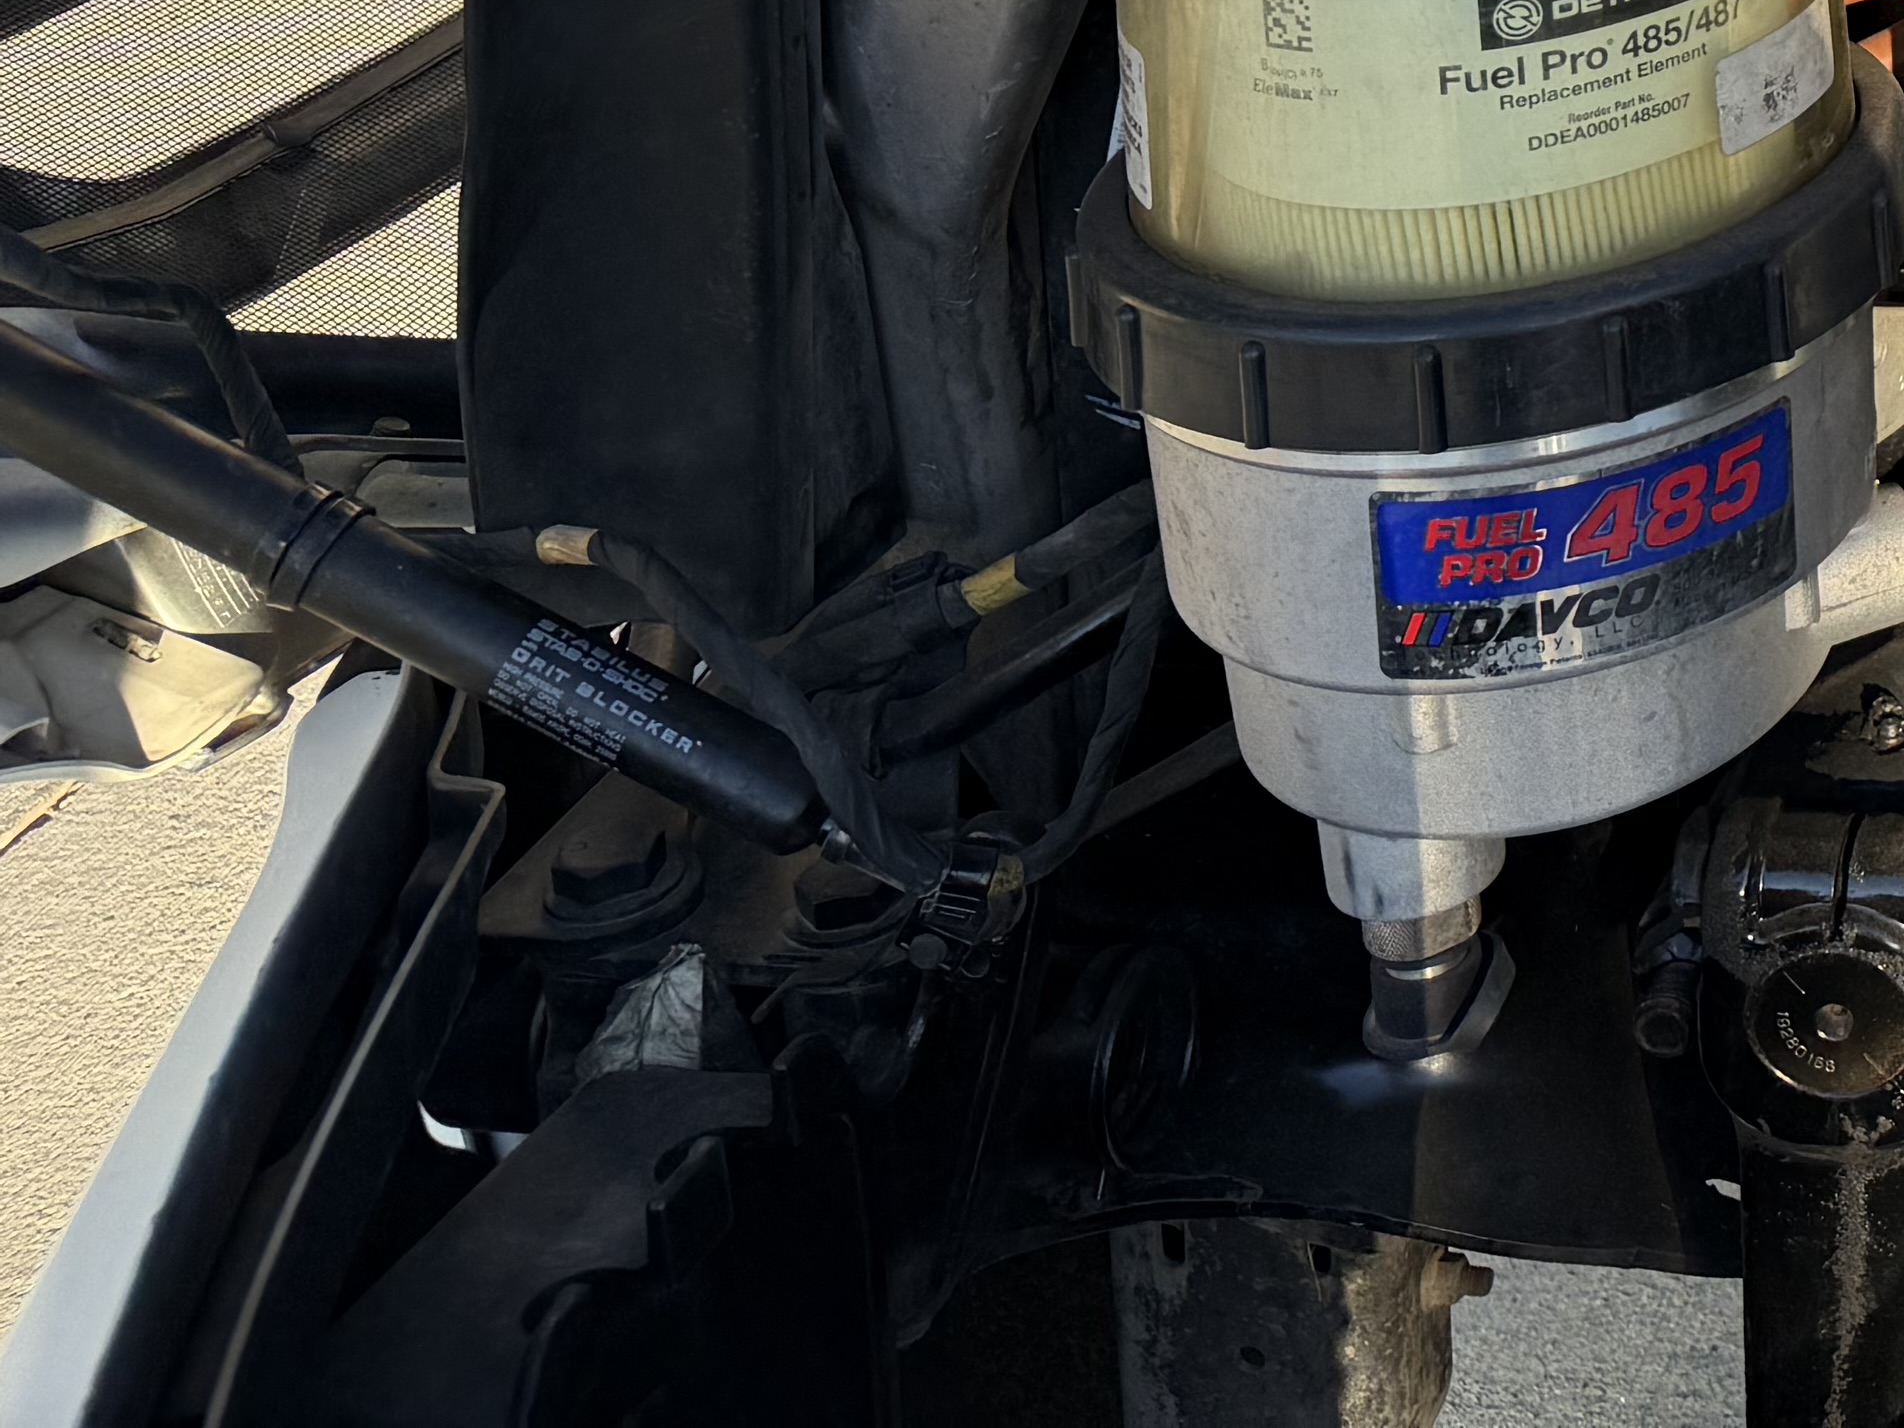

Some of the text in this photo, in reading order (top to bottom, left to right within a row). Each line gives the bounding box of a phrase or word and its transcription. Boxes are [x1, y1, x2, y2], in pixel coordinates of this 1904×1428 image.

[1252, 77, 1314, 101] EleMax
[1438, 55, 1527, 96] Fuel
[1499, 42, 1709, 111] Replacement Element
[1527, 92, 1691, 152] DDEA0001485007
[1567, 92, 1657, 126] Reorder Part No.
[1423, 506, 1548, 554] FUEL
[1563, 433, 1765, 568] 485
[1438, 544, 1544, 588] PRO
[1457, 573, 1661, 645] DAVCO
[536, 618, 670, 693] STABILUS
[574, 680, 694, 754] BLOCKER
